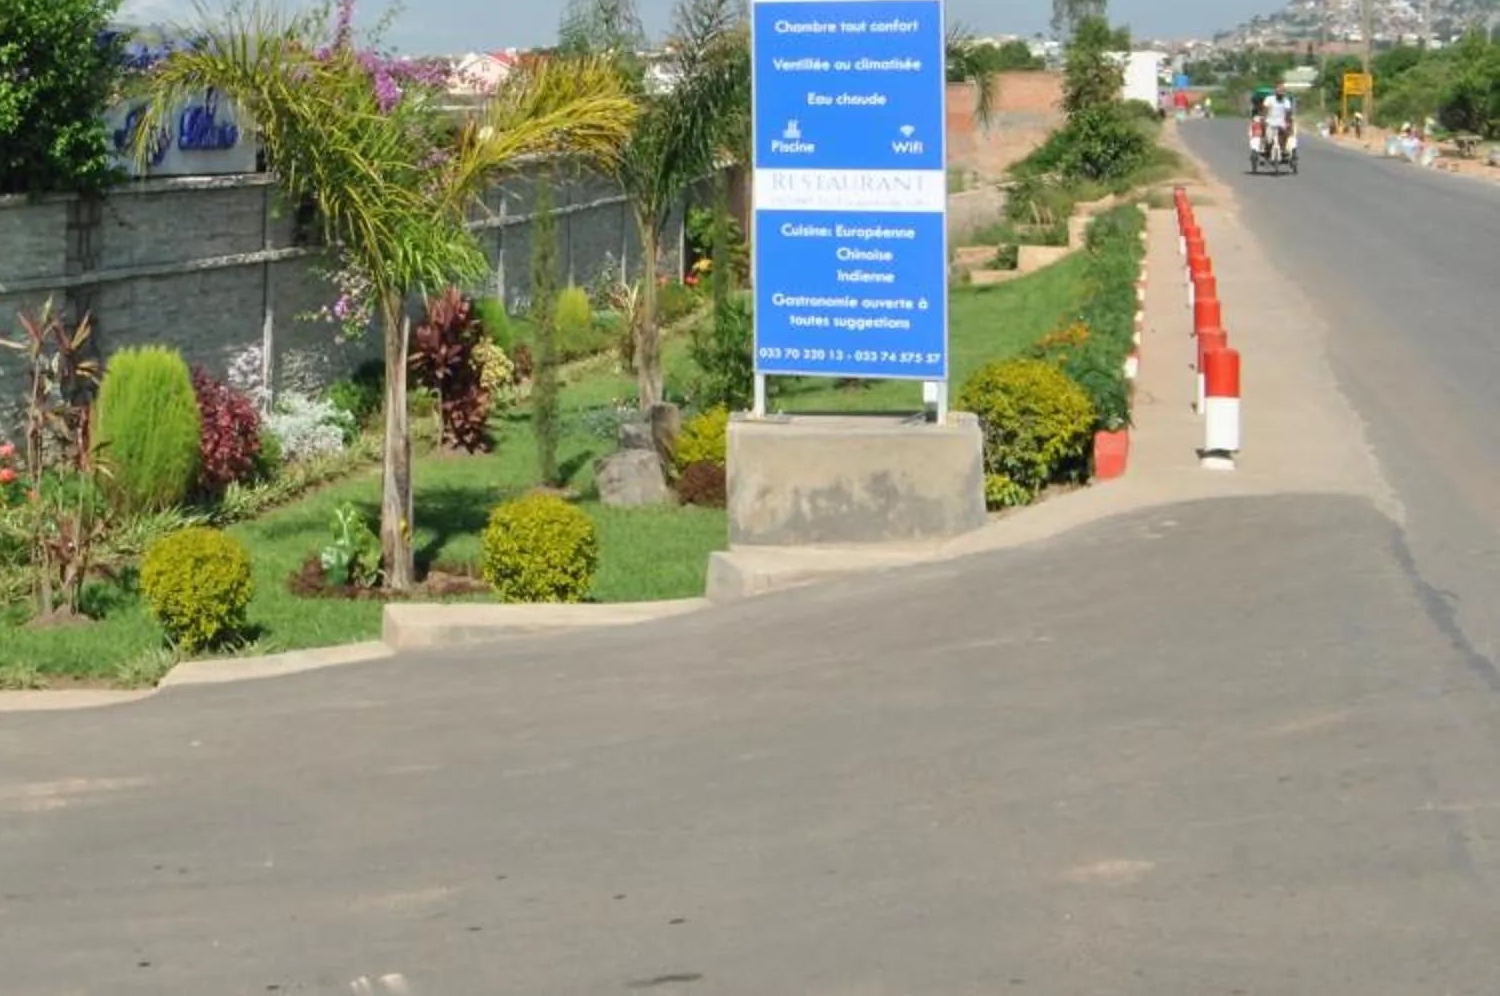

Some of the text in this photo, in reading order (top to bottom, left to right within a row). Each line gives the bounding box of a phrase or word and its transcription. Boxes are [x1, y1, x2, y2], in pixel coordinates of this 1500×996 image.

[774, 18, 919, 34] Chambre tout confort
[833, 60, 852, 71] ou
[807, 92, 887, 106] Eau chaude
[771, 139, 815, 153] Piscine
[892, 140, 924, 154] Wifi
[772, 172, 925, 192] RESTAURANT
[835, 246, 893, 262] Chinoise
[837, 269, 895, 283] Indienne
[771, 293, 859, 308] Gastronomie
[860, 298, 914, 310] ouverte
[789, 315, 911, 331] toutes suggestions
